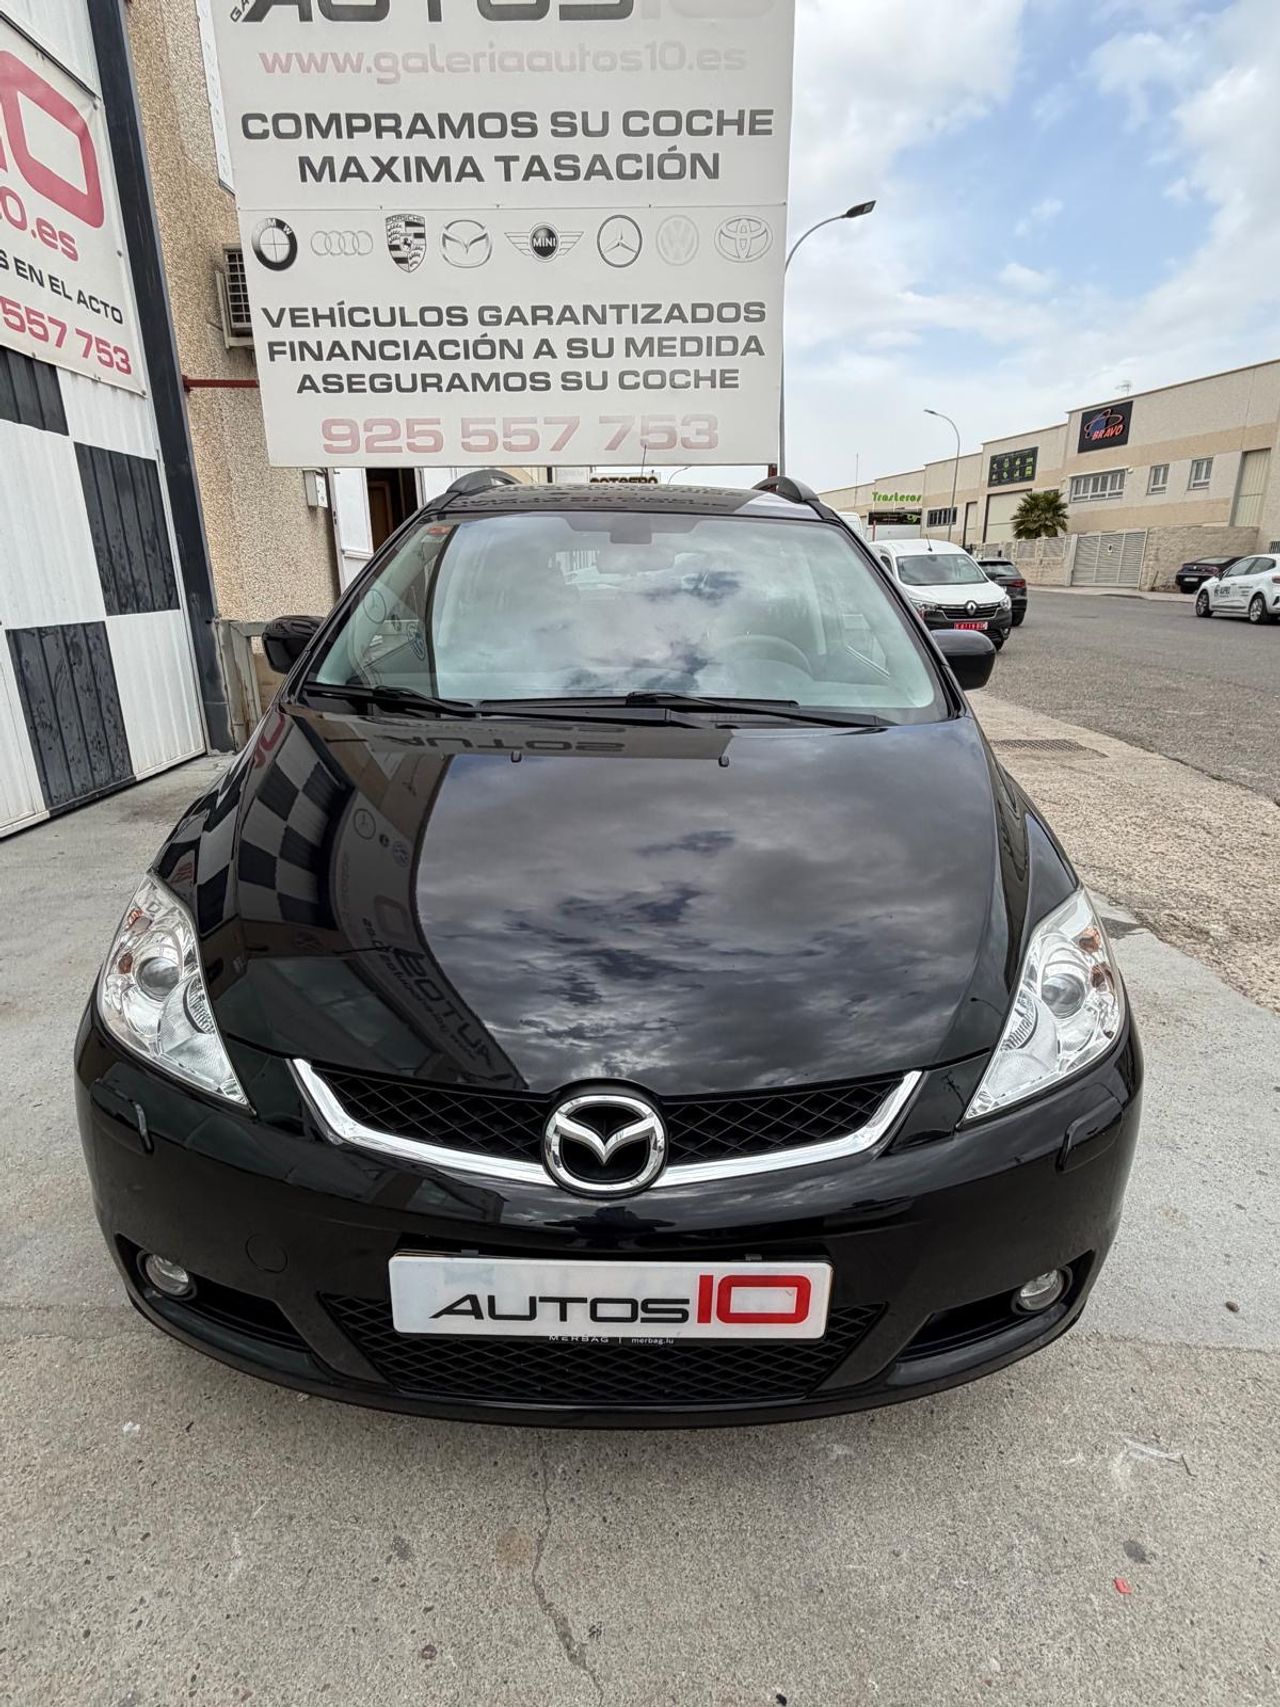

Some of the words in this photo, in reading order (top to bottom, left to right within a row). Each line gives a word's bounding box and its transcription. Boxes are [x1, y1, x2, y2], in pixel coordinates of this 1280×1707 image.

[258, 41, 748, 84] www.galeriaautos10.es
[241, 111, 539, 140] COMPRAMOS
[550, 110, 610, 138] SU
[622, 109, 774, 138] COCHE
[297, 155, 485, 183] MAXIMA
[493, 144, 720, 183] TASACIÓN
[532, 235, 556, 248] MINI
[13, 256, 44, 288] EN
[48, 274, 72, 301] EL
[77, 289, 123, 324] ACTO
[261, 300, 469, 328] VEHÍCULOS
[477, 301, 766, 326] GARANTIZADOS
[0, 295, 67, 348] 557
[75, 327, 131, 375] 753
[267, 333, 524, 362] FINANCIACIÓN
[532, 338, 558, 360] A
[566, 337, 615, 359] SU
[624, 335, 766, 358] MEDIDA
[296, 371, 552, 394] ASEGURAMOS
[560, 370, 608, 392] SU
[618, 368, 739, 391] COCHE
[321, 417, 443, 454] 925
[460, 416, 580, 453] 557
[598, 414, 718, 452] 753
[1091, 424, 1124, 441] BRAVO
[871, 491, 922, 502] Trasteros
[429, 1274, 811, 1324] AUTOS10
